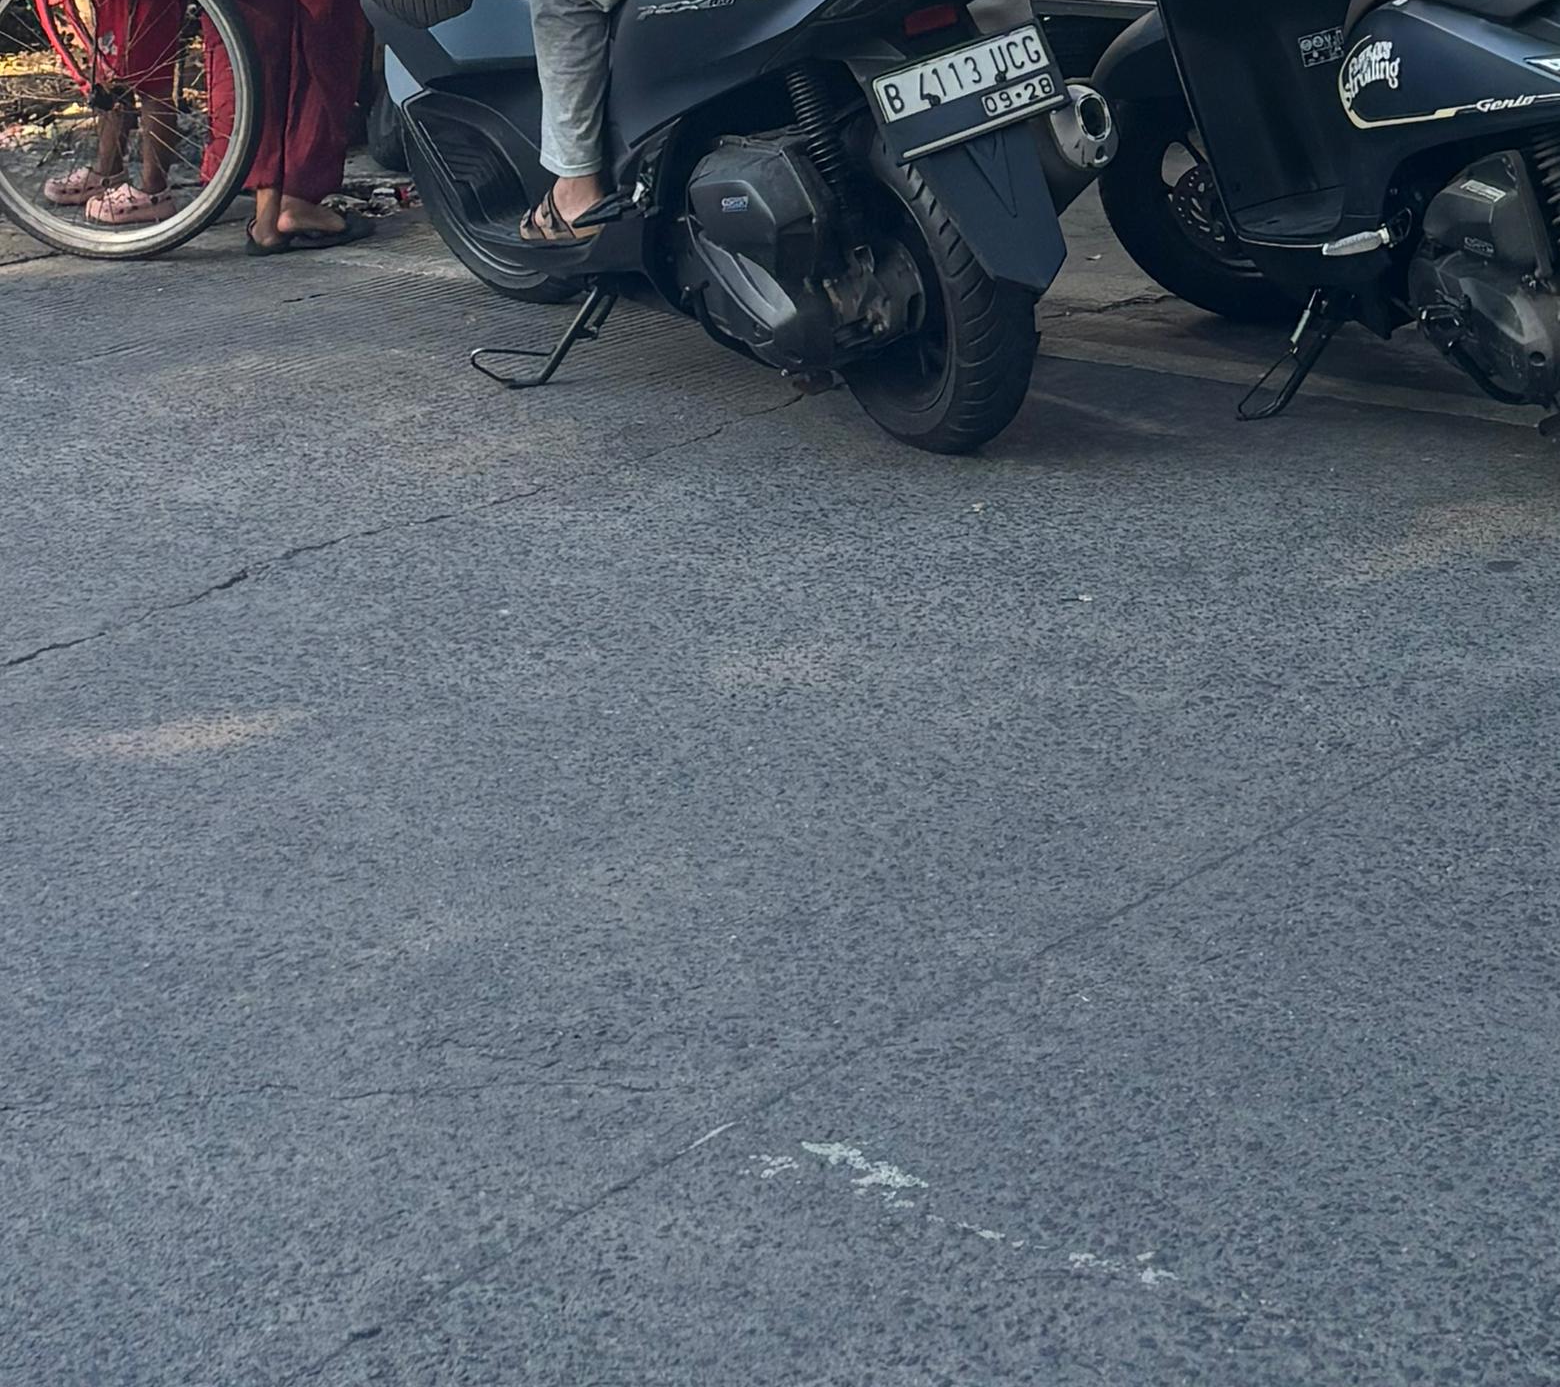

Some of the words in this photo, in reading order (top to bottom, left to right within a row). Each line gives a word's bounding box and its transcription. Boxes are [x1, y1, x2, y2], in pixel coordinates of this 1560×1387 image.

[883, 83, 905, 115] B
[919, 55, 983, 104] 4113
[988, 34, 1042, 79] UCG
[1475, 94, 1537, 113] Genio
